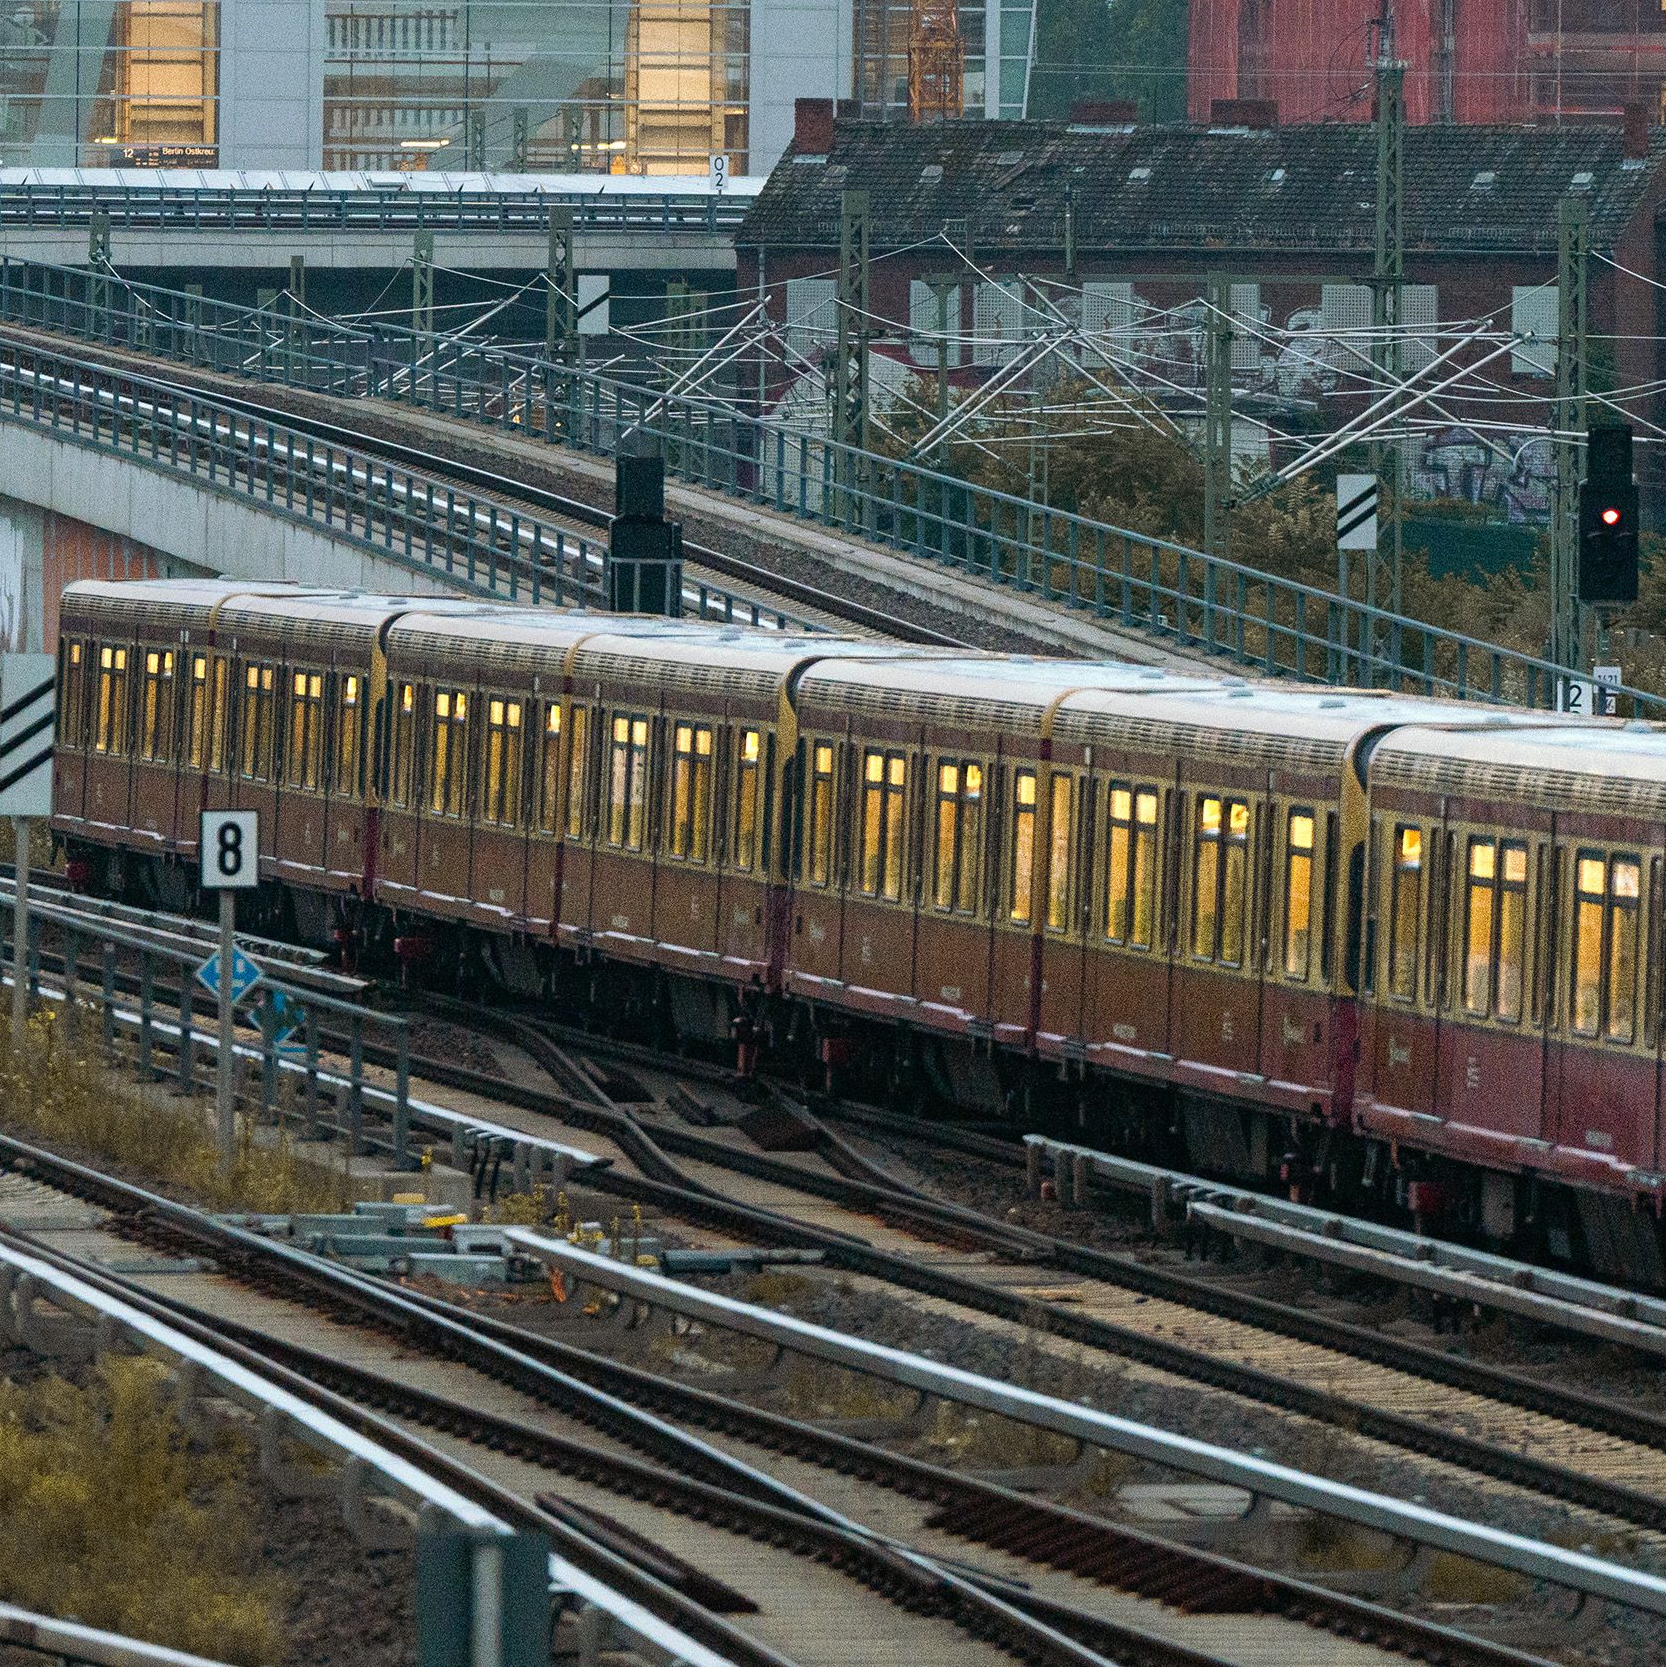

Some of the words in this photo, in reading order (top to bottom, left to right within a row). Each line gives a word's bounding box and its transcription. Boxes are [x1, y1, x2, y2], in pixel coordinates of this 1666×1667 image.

[123, 148, 133, 158] 12
[162, 147, 183, 155] Berlin
[715, 172, 724, 187] 2
[217, 821, 242, 876] 8
